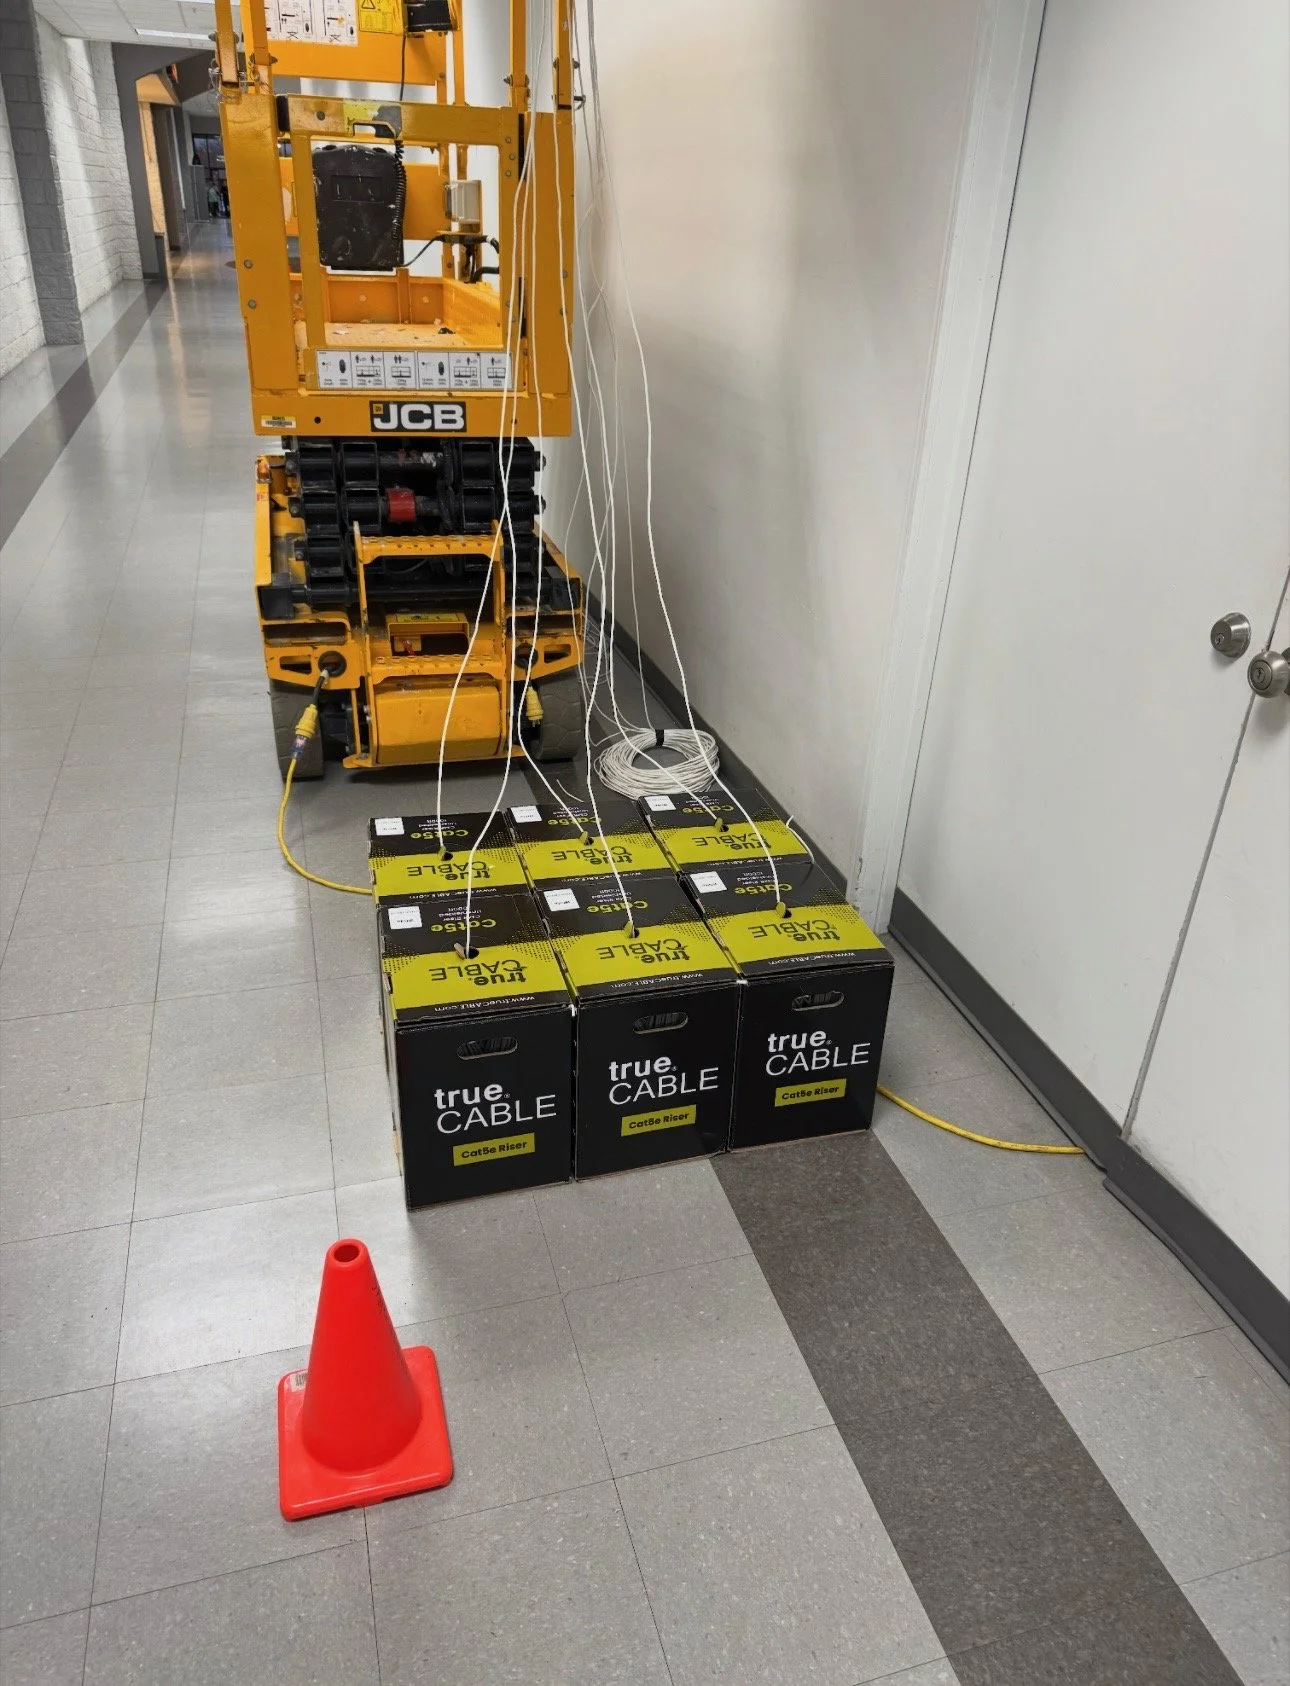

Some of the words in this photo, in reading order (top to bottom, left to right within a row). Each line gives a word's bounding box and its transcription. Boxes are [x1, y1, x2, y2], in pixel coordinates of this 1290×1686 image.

[373, 404, 465, 430] JCB
[683, 804, 735, 814] Ca5e
[551, 846, 626, 861] CABLE
[406, 861, 487, 877] CABLE
[734, 883, 792, 895] Cat5e
[430, 918, 497, 933] Cat5e
[748, 919, 831, 938] CABLE
[598, 938, 683, 960] CABLE
[428, 959, 522, 982] CABLE
[765, 1042, 871, 1076] CABLE
[608, 1067, 719, 1105] CABLE
[782, 1089, 812, 1100] Cat5e
[814, 1086, 840, 1096] Riser
[436, 1094, 557, 1134] CABLE
[628, 1115, 661, 1129] Cat5e
[663, 1112, 689, 1125] Riser
[461, 1144, 496, 1159] Cat5e
[498, 1140, 527, 1153] Riser
